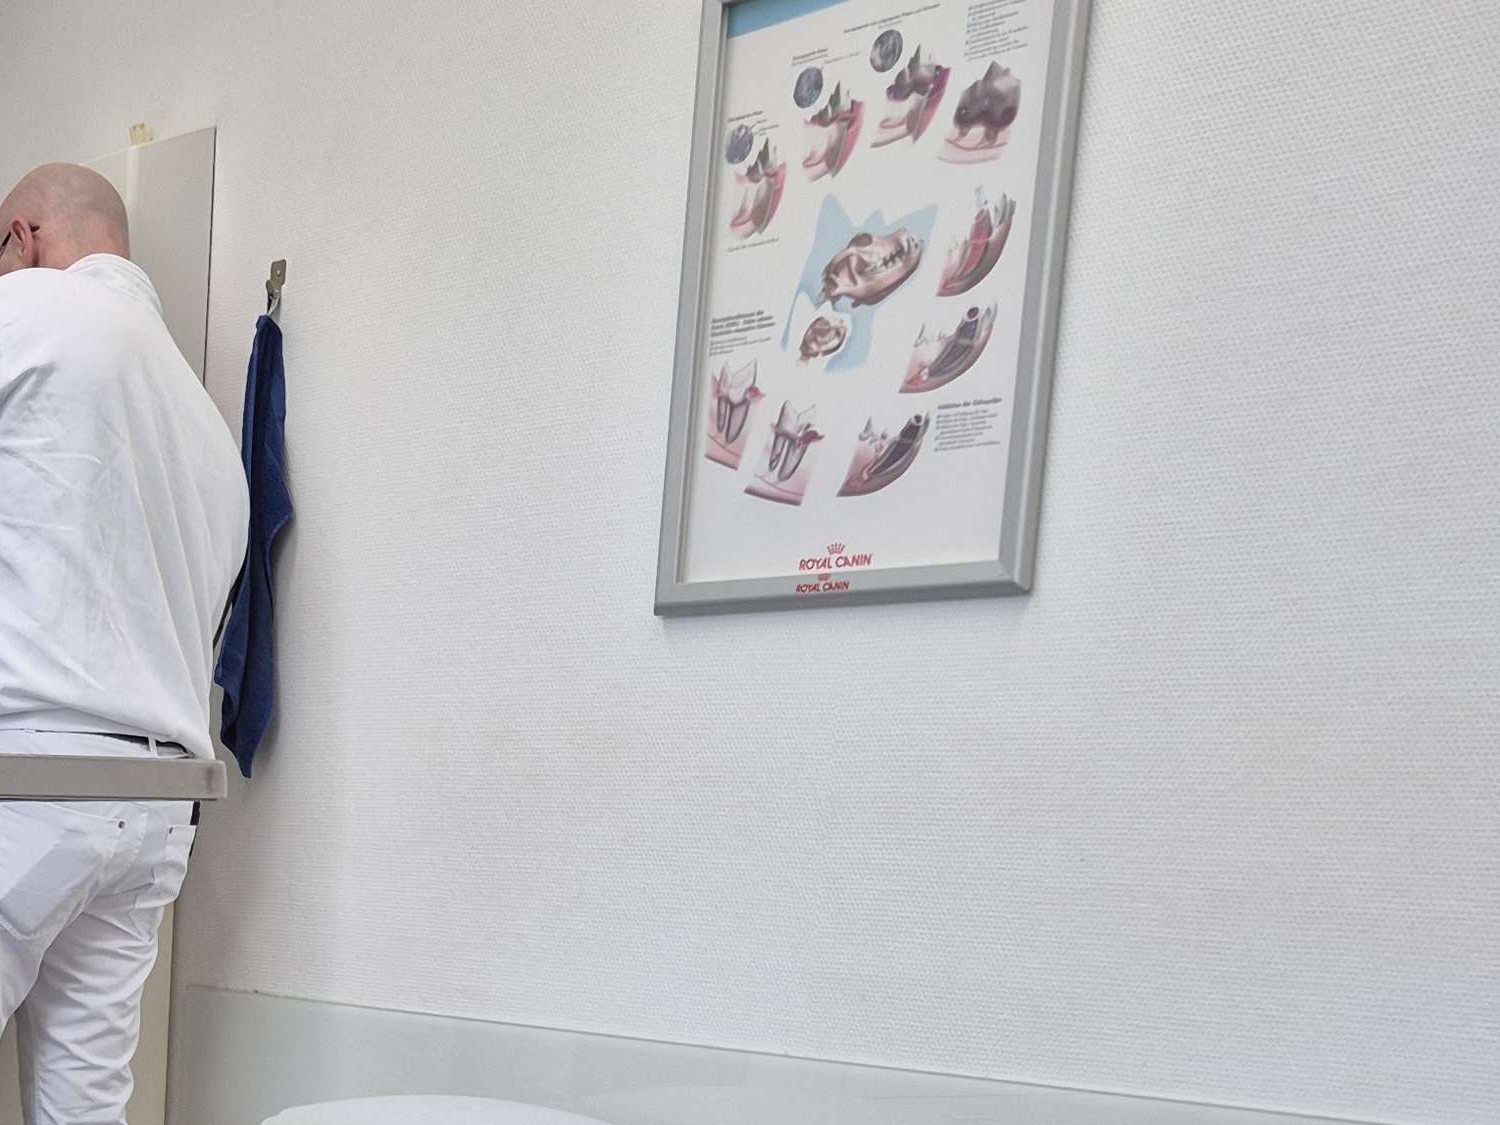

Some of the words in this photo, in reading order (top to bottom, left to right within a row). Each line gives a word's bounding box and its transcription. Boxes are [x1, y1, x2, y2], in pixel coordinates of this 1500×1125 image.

[798, 557, 833, 571] ROYAL
[835, 554, 872, 568] CANIN
[796, 583, 821, 593] ROYAL
[822, 581, 850, 592] CANIN
